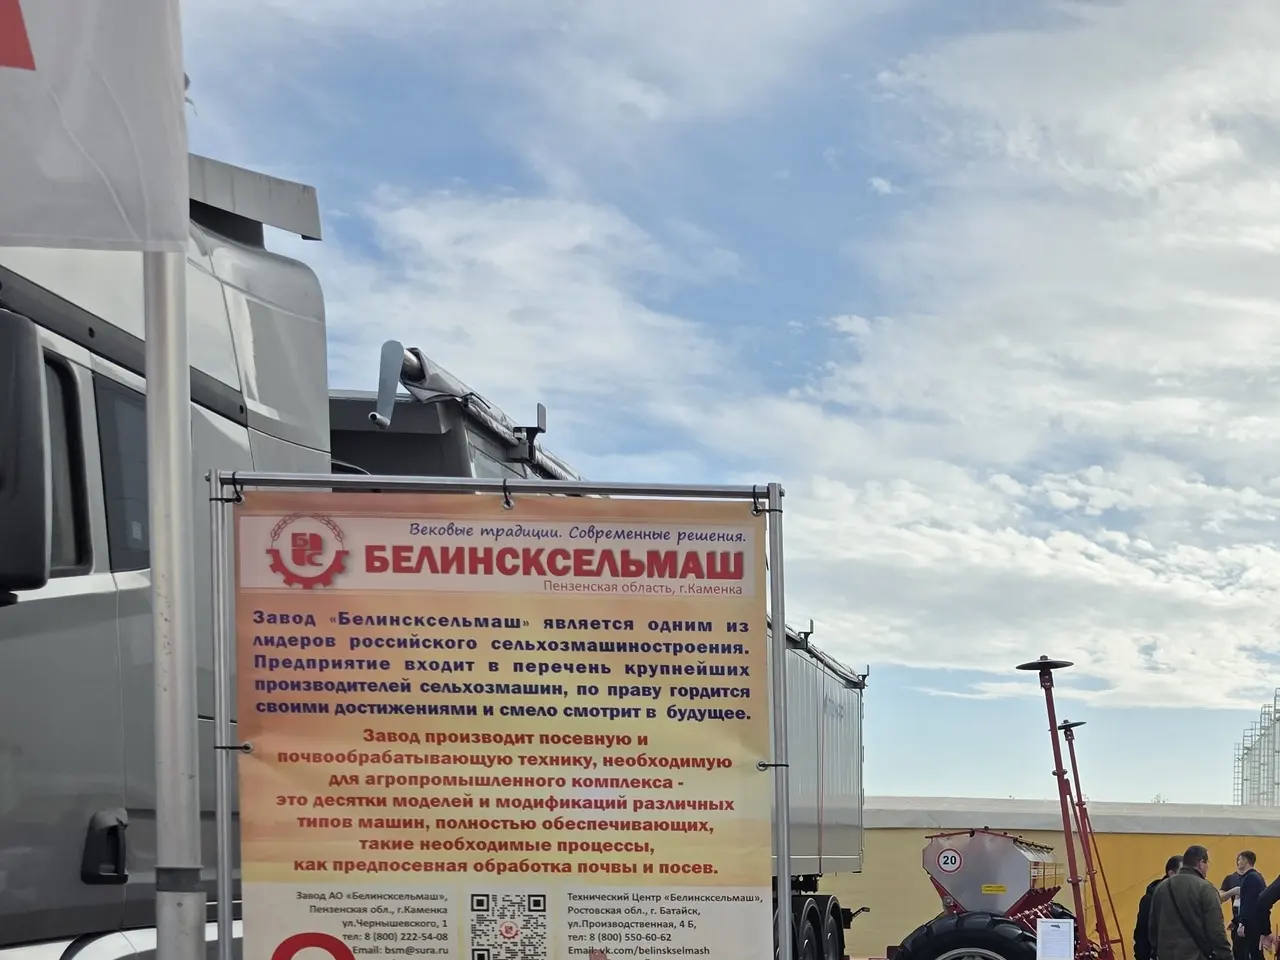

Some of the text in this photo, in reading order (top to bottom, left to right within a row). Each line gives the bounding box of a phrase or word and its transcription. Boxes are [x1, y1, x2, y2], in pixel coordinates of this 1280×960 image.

[409, 521, 747, 546] Вековые традиции. Современные решения.
[364, 544, 745, 581] БЕЛИНСКСЕЛЬМАШ
[543, 578, 743, 596] Пензенская область, г.Каменка
[252, 610, 750, 634] Завод «Белинсксельмаш» является одним из
[252, 633, 750, 657] лидеров российского сельхозмашиностроения.
[254, 654, 751, 679] Предприятие входит в перечень крупнейших
[254, 677, 751, 701] производителей сельхозмашин, по праву гордится
[255, 702, 752, 723] своими достижениями и смело смотрит в будущее.
[363, 728, 649, 749] Завод производит посевную и
[277, 748, 733, 772] почвообрабатывающую технику, необходимую
[328, 774, 360, 788] для
[364, 774, 567, 789] агропромышленного
[571, 777, 673, 789] комплекса
[276, 792, 735, 813] это десятки моделей и модификаций различных
[296, 815, 714, 835] типов машин, полностью обеспечивающих,
[358, 836, 655, 856] такие необходимые процессы,
[293, 857, 719, 876] как предпосевная обработка почвы и посев.
[942, 855, 957, 866] 20
[296, 891, 327, 902] Завод
[327, 891, 344, 901] АО
[566, 892, 630, 902] Технический
[631, 892, 662, 904] Центр
[309, 904, 369, 914] Пензенская
[396, 905, 449, 915] г.Каменка
[567, 905, 622, 915] Ростовская
[441, 919, 448, 928] 1
[678, 919, 686, 929] 4
[342, 931, 449, 943] тел: 8 (800) 222-54-08
[567, 932, 672, 944] тел: 8 (800) 550-60-62
[352, 945, 449, 956] Email: bsm@sura.ru
[568, 946, 709, 957] Email: vk.com/belinskselmash
